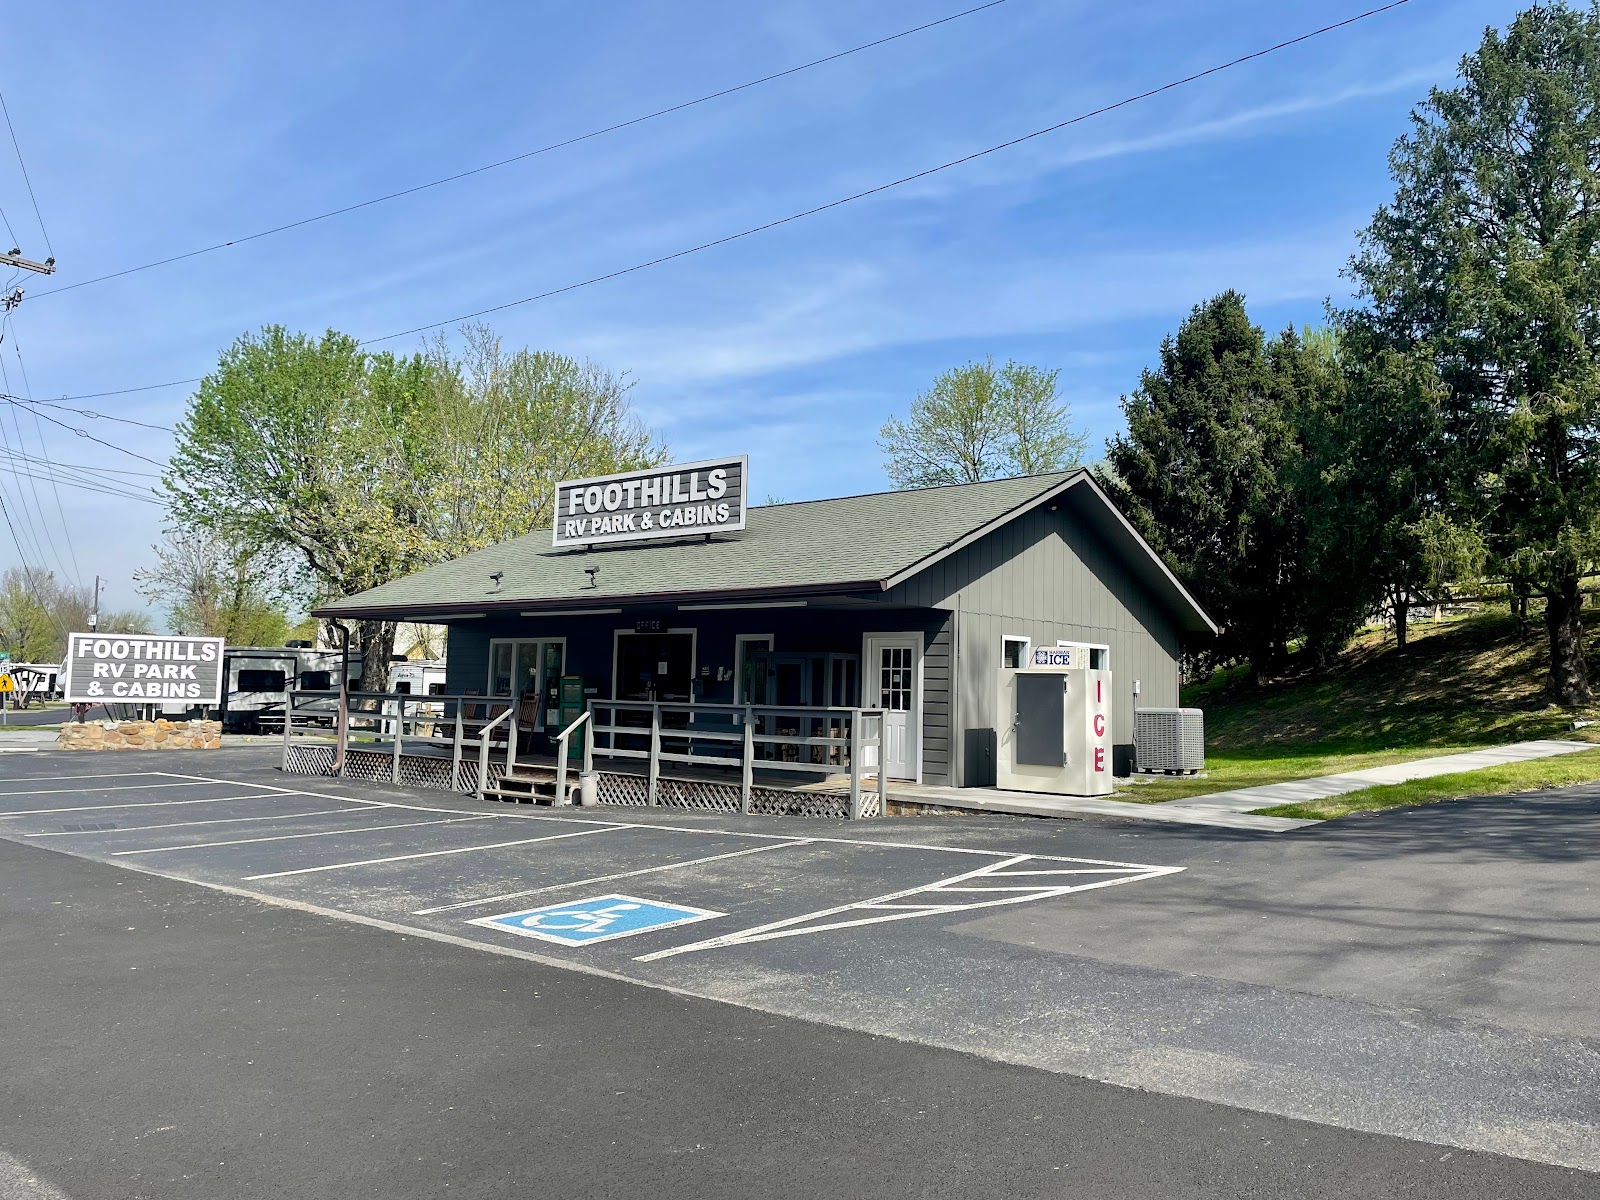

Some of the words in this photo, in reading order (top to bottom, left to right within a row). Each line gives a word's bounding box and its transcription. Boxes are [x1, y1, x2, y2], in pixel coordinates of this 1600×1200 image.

[568, 468, 727, 515] FOOTHILLS
[565, 518, 587, 538] RV
[591, 513, 636, 535] PARK
[640, 511, 654, 530] &
[659, 503, 730, 528] CABINS
[636, 620, 660, 630] OFFICE
[77, 638, 216, 662] FOOTHILLS
[1049, 655, 1070, 665] ICE
[93, 662, 127, 678] RV
[133, 663, 197, 680] PARK
[87, 681, 105, 697] &
[112, 681, 201, 698] CABINS
[1093, 680, 1105, 772] ICE
